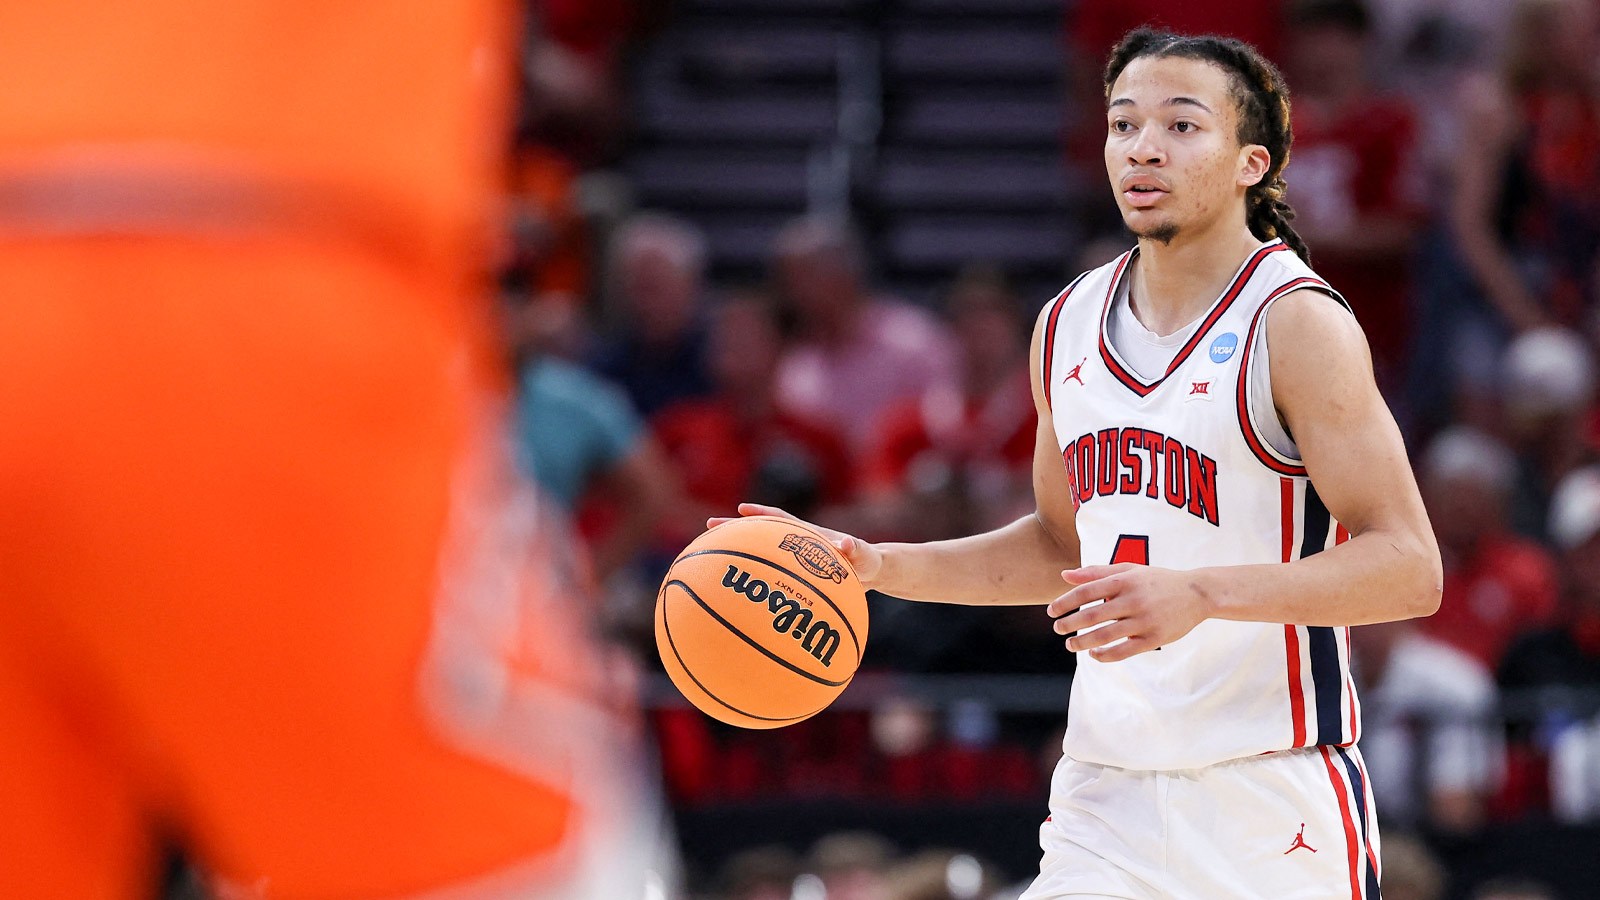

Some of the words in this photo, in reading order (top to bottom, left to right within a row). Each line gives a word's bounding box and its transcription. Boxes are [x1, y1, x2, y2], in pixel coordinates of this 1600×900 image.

[1212, 346, 1235, 355] NCAA
[1189, 381, 1210, 395] XII
[1063, 427, 1219, 527] HOUSTON
[784, 533, 836, 564] MADNESS
[798, 548, 836, 575] MARCH
[774, 581, 794, 594] NXT
[795, 592, 814, 607] EVO
[720, 564, 841, 668] Wilson
